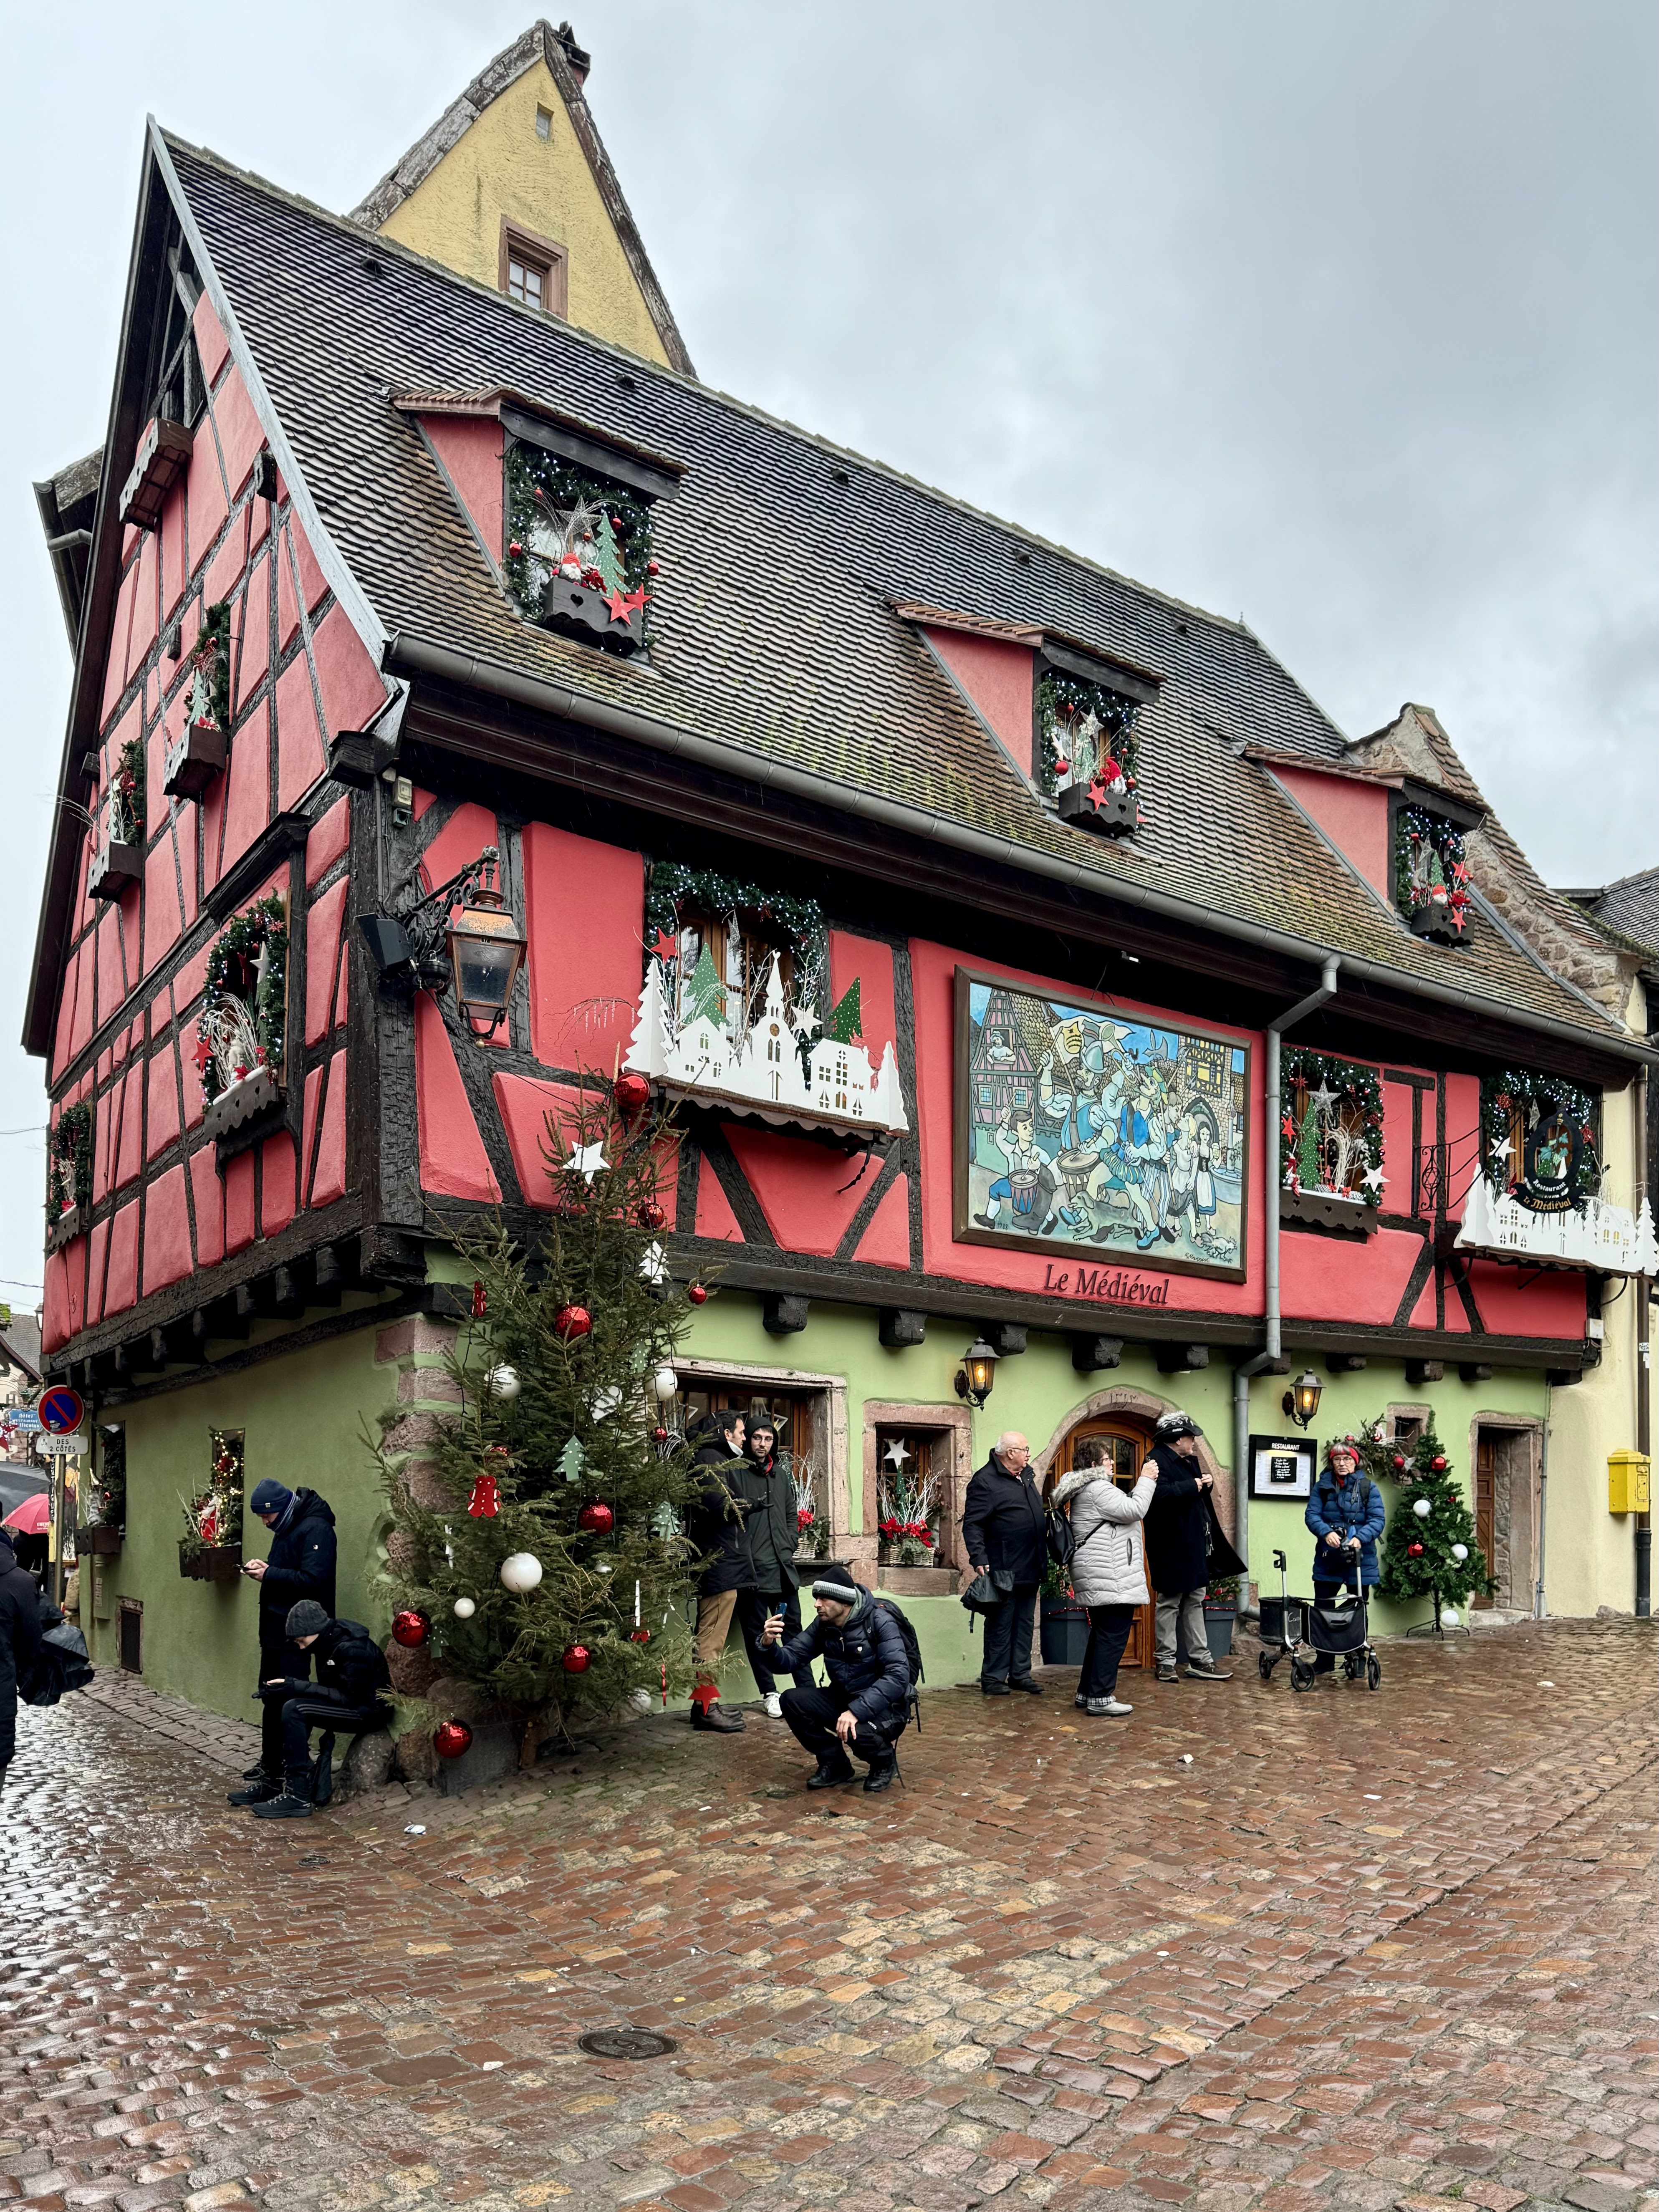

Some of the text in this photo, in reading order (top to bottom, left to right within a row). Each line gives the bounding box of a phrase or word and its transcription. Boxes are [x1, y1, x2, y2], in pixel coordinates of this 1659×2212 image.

[1533, 1179, 1566, 1192] Restaurant
[1523, 1196, 1572, 1210] Le Médiéval
[1044, 1264, 1170, 1305] Le Médiéval
